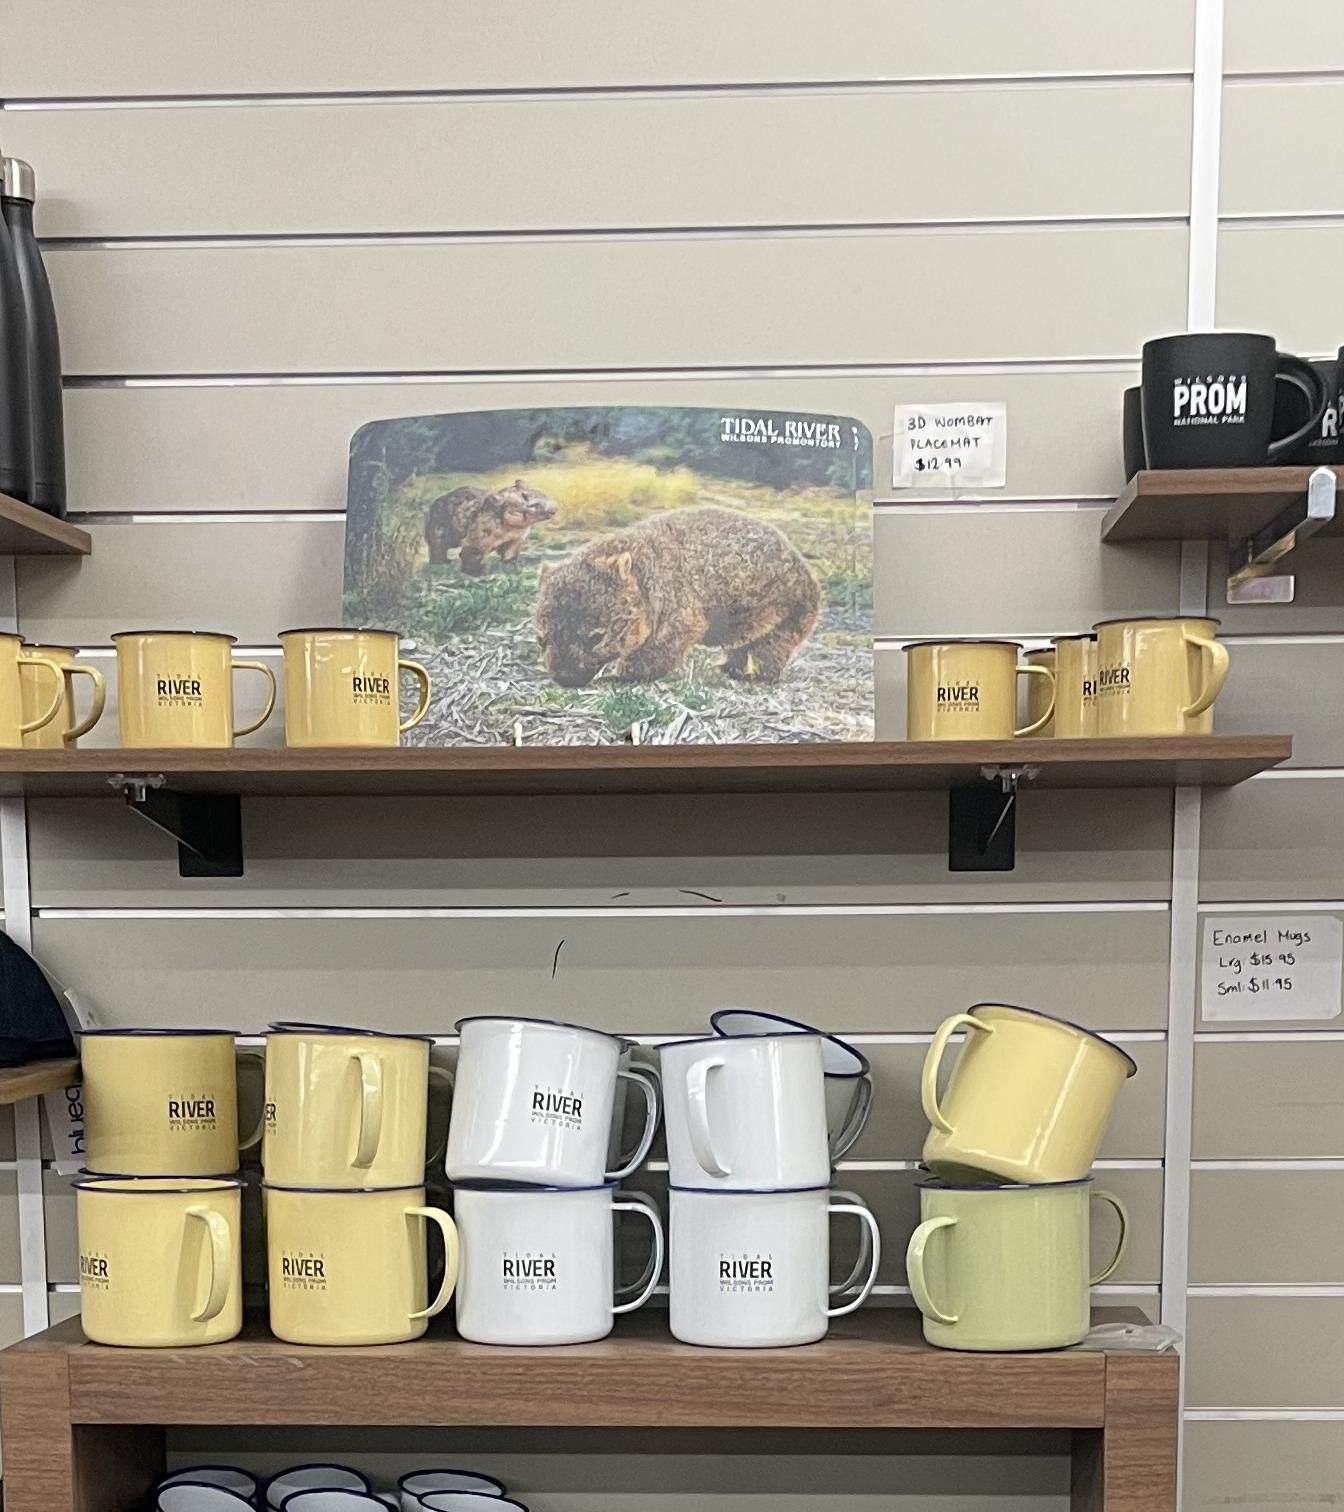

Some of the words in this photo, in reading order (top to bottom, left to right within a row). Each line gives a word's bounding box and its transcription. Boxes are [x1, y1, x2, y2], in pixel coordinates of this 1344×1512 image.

[1174, 383, 1247, 417] PROM
[720, 416, 780, 437] TIDAL
[785, 420, 841, 441] RIVER
[907, 416, 926, 430] 3D
[934, 415, 993, 429] WOMBAT
[910, 437, 982, 451] PLACEMAT
[1099, 668, 1130, 684] RIVER
[157, 680, 202, 696] RIVER
[353, 677, 390, 694] RIVER
[937, 686, 979, 702] RIVER
[1213, 930, 1267, 946] Enamel
[1278, 929, 1311, 946] Mugs
[1219, 956, 1242, 974] Lrg
[1217, 982, 1241, 996] Sml
[169, 1100, 216, 1118] RIVER
[532, 1091, 582, 1118] RIVER
[80, 1255, 108, 1278] RIVER
[282, 1257, 325, 1278] RIVER
[503, 1259, 555, 1277] RIVER
[720, 1260, 773, 1279] RIVER
